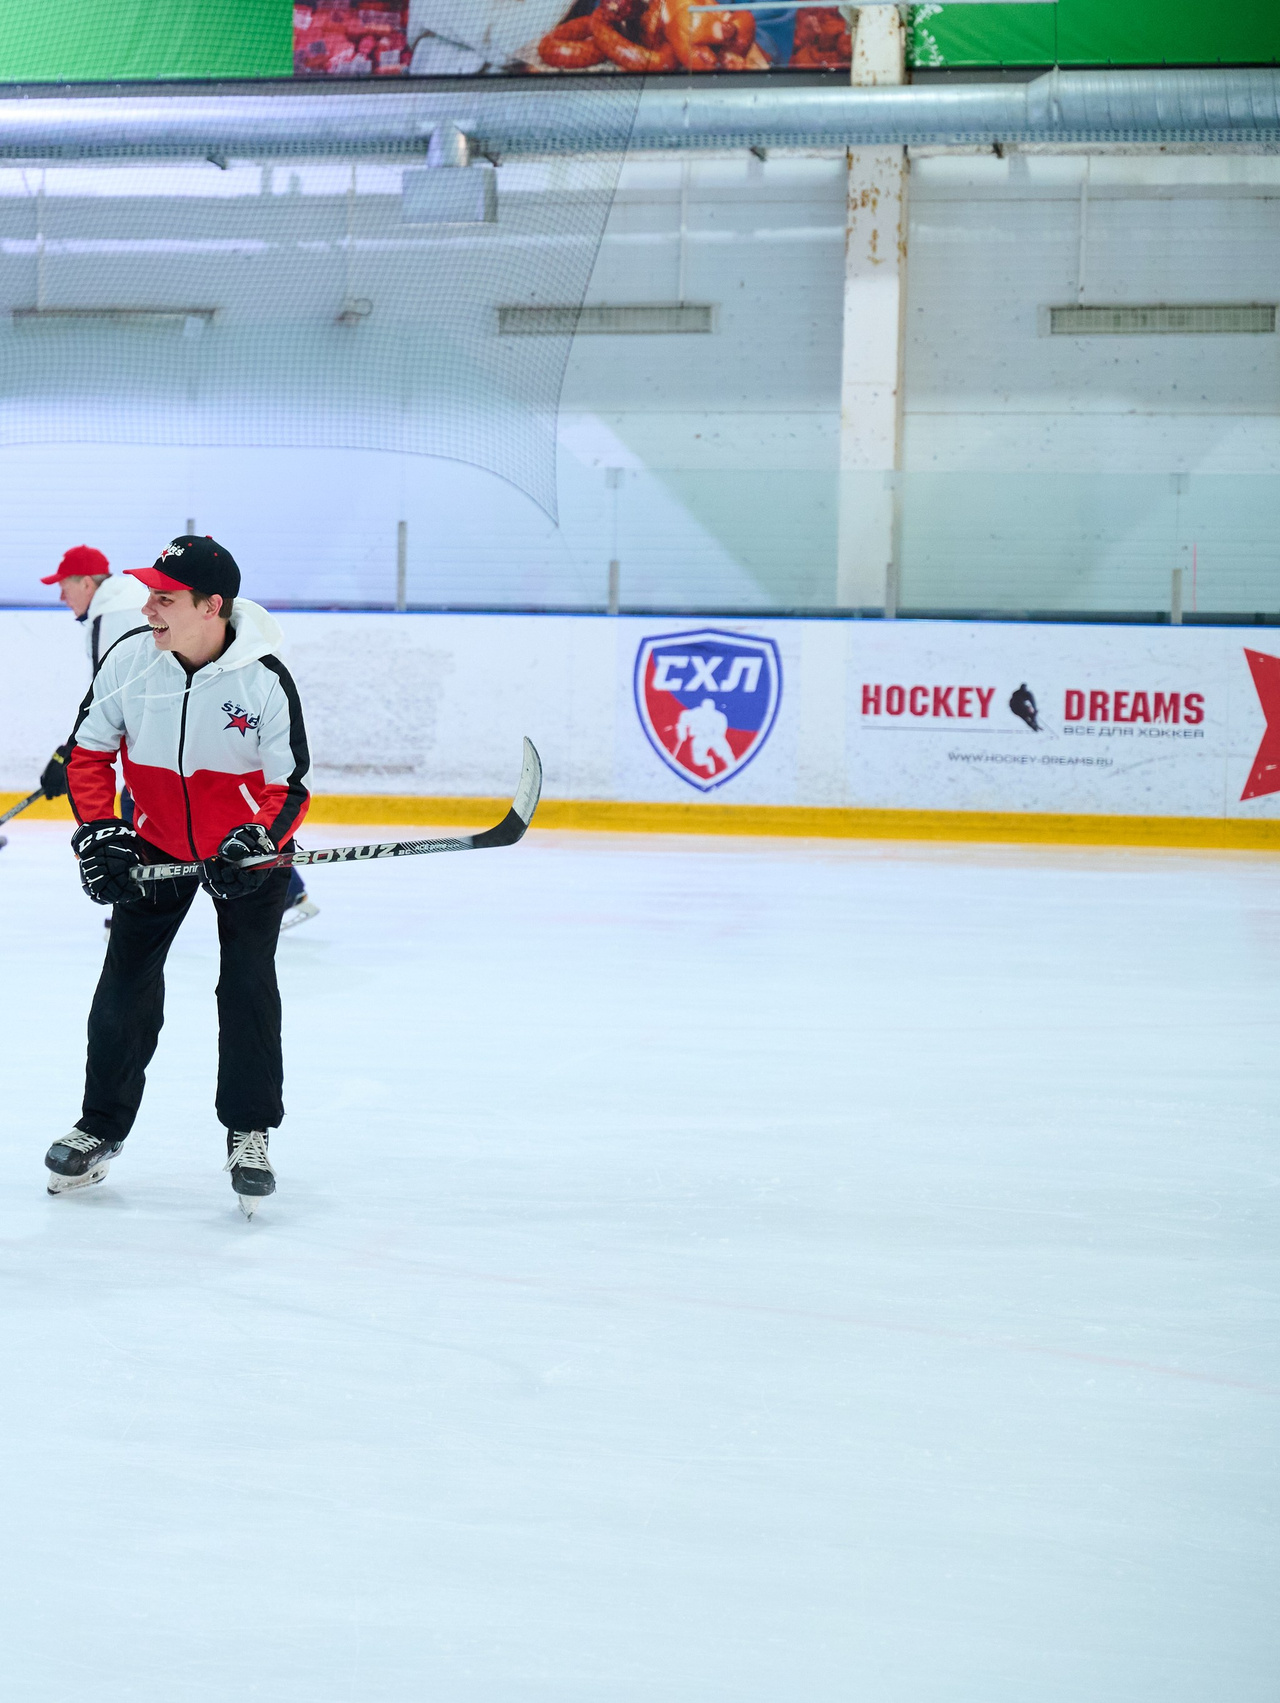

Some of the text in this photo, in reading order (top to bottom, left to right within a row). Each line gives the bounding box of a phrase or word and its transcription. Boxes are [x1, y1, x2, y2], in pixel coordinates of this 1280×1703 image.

[652, 655, 763, 692] СХЛ
[862, 684, 1205, 725] HOCKEY DREAMS
[1063, 726, 1205, 739] ВСЕ ДЛЯ ХОККЕЯ
[79, 826, 137, 852] CCM
[291, 843, 399, 866] SOYUZ
